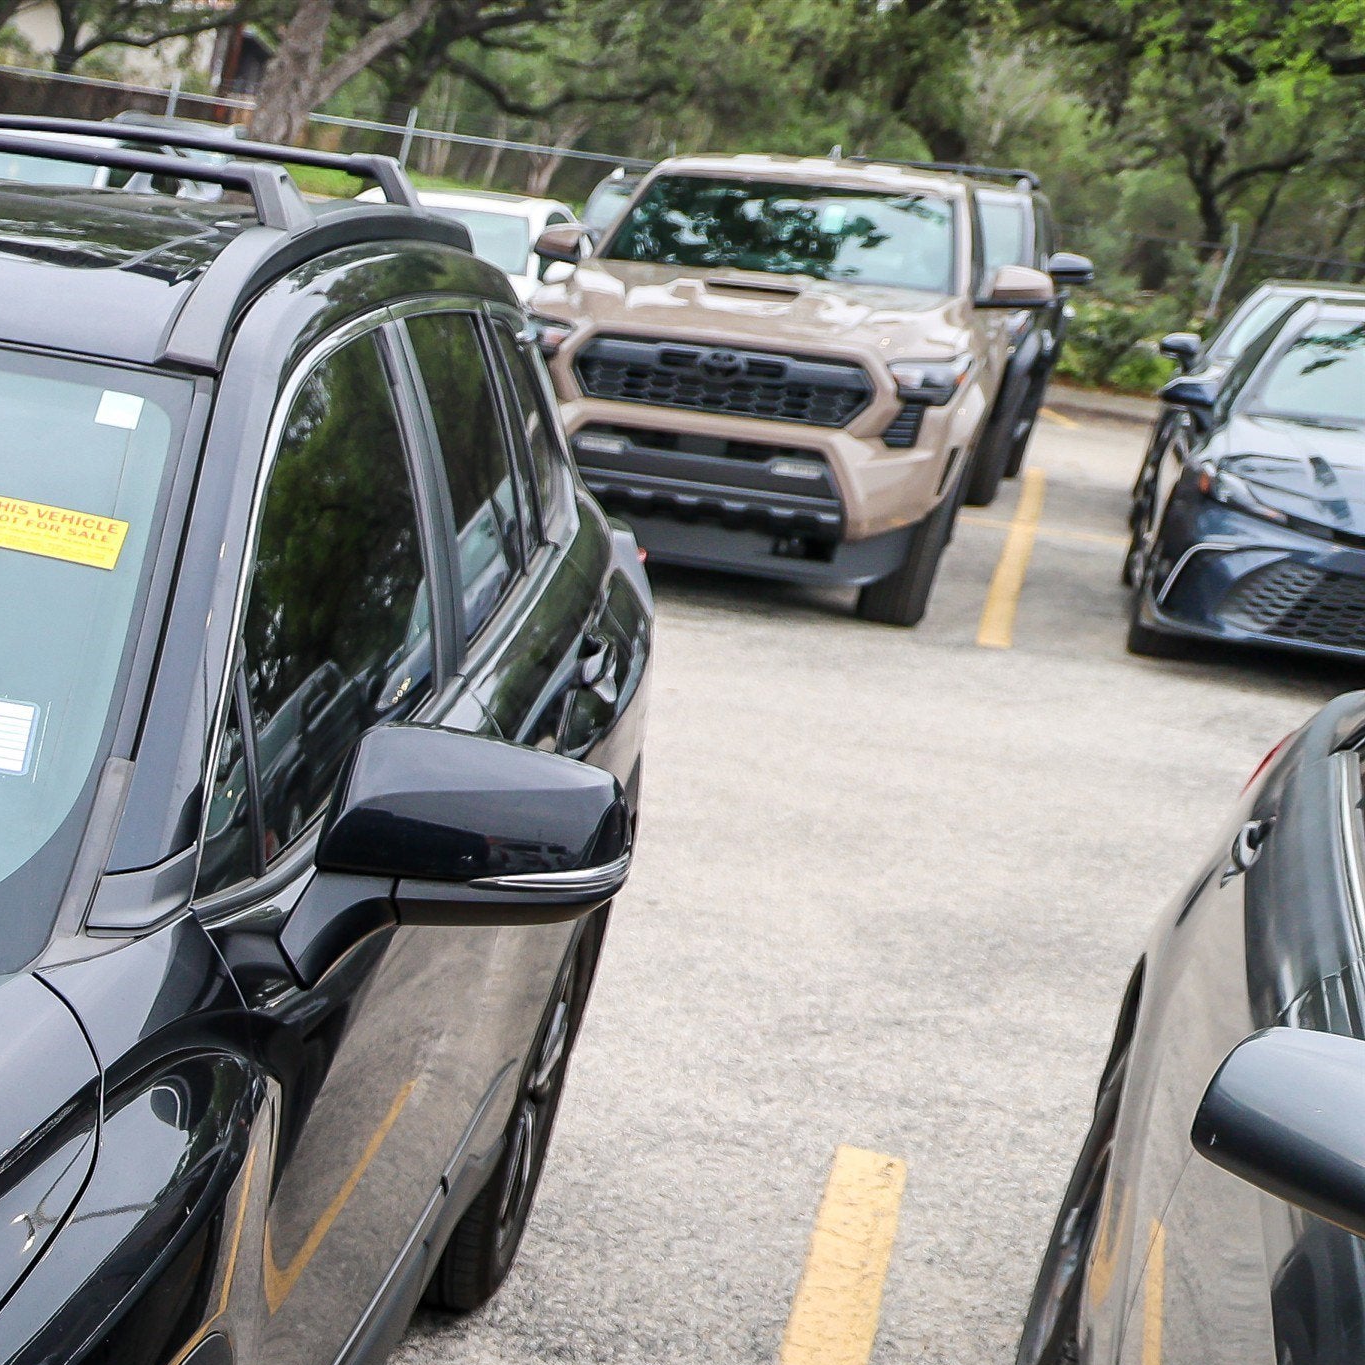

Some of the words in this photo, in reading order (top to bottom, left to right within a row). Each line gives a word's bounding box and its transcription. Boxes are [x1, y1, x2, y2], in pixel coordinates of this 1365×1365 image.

[25, 519, 61, 533] FOR
[68, 528, 109, 543] SALE
[37, 508, 119, 535] VEHICLE
